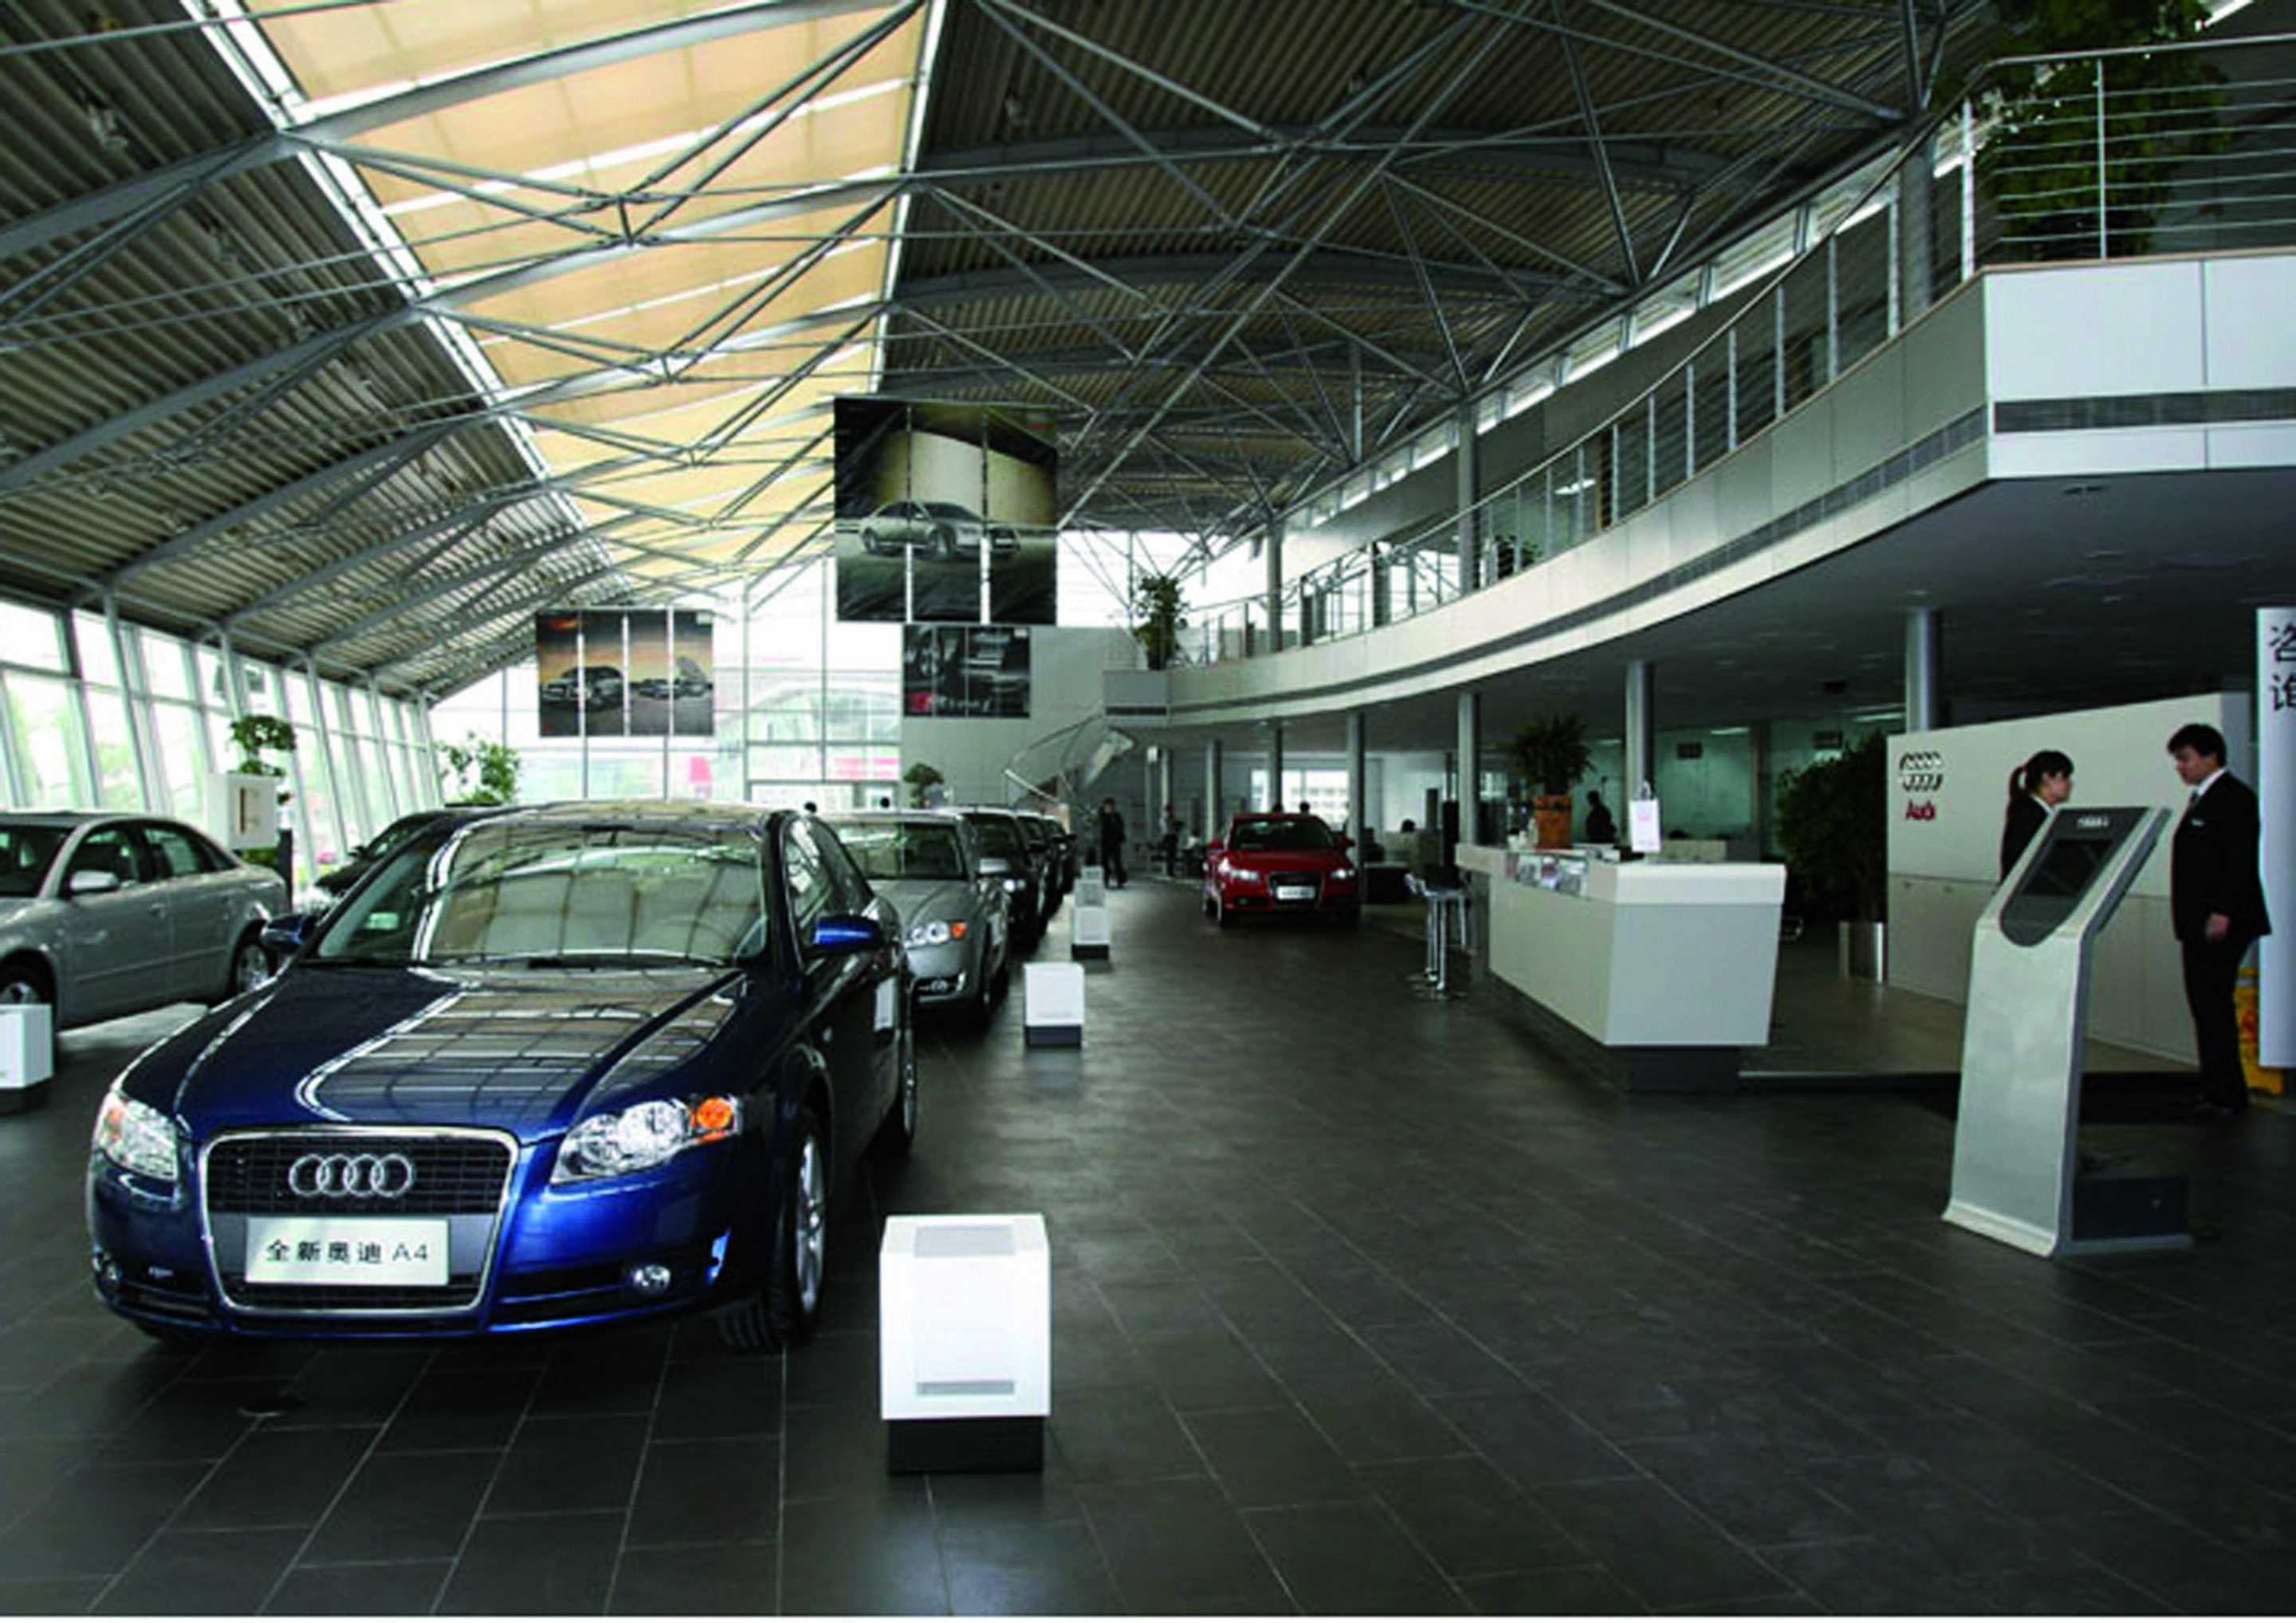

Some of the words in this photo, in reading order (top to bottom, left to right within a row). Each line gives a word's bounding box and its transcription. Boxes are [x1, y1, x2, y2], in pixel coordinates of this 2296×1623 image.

[1905, 800, 1936, 821] Audi
[266, 1238, 382, 1263] 全新奥迪
[391, 1243, 428, 1262] A4
